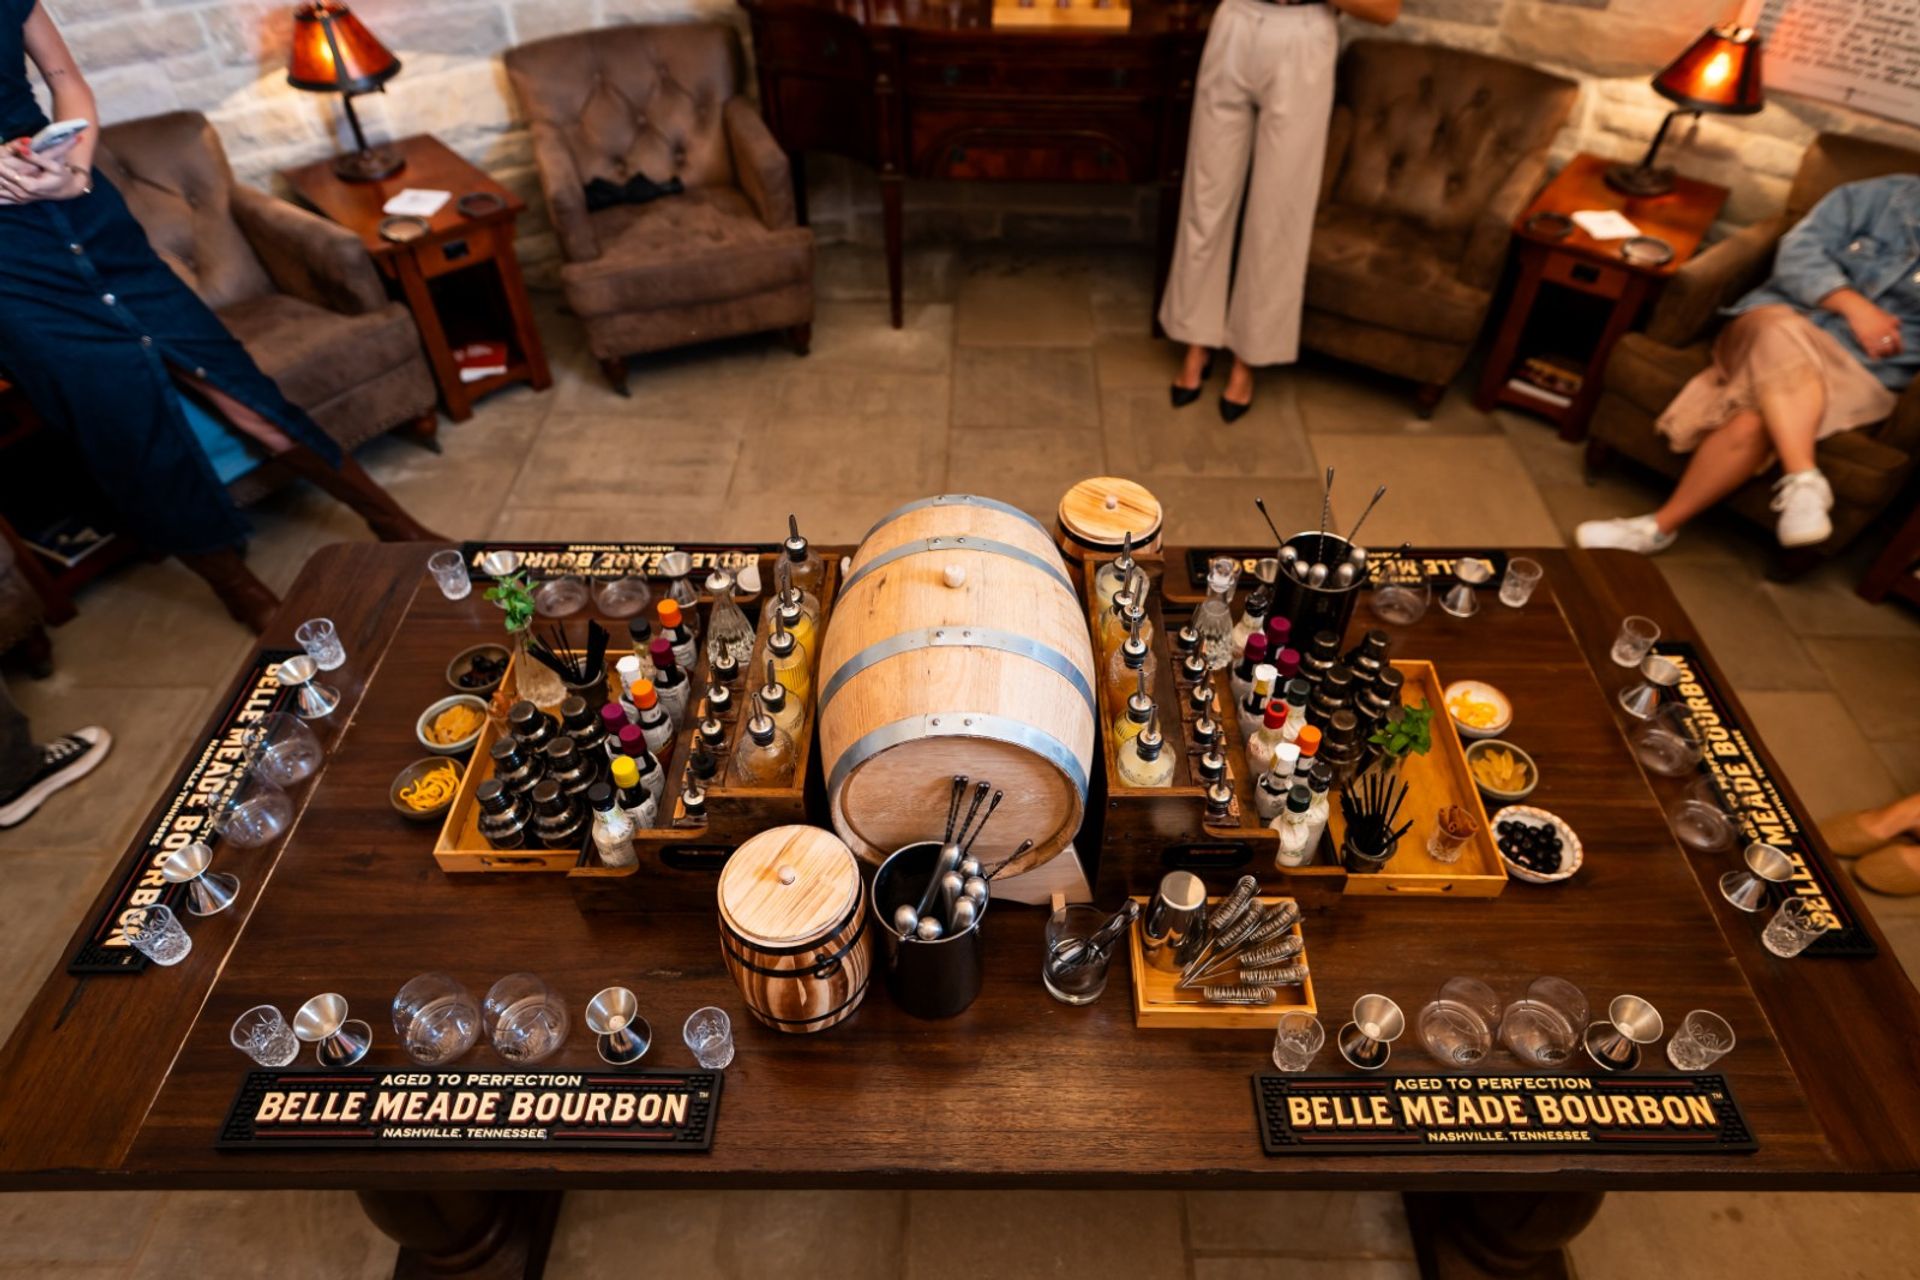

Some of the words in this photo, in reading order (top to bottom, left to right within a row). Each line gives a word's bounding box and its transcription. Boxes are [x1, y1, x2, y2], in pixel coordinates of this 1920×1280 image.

[600, 552, 690, 569] EADE
[187, 727, 256, 809] MEADE
[1724, 762, 1793, 846] MEADE
[380, 1074, 429, 1086] AGED
[436, 1074, 461, 1086] TO
[466, 1074, 582, 1087] PERFECTION
[1394, 1078, 1441, 1090] AGED
[1445, 1078, 1472, 1089] TO
[1477, 1077, 1592, 1090] PERFECTION
[255, 1091, 365, 1123] BELLE
[370, 1091, 501, 1123] MEADE
[508, 1091, 690, 1124] BOURBON
[1287, 1096, 1394, 1128] BELLE
[1400, 1095, 1528, 1127] MEADE
[1534, 1095, 1719, 1126] BOURBON
[467, 1128, 547, 1139] TENNESSEE
[1510, 1131, 1591, 1142] TENNESSEE
